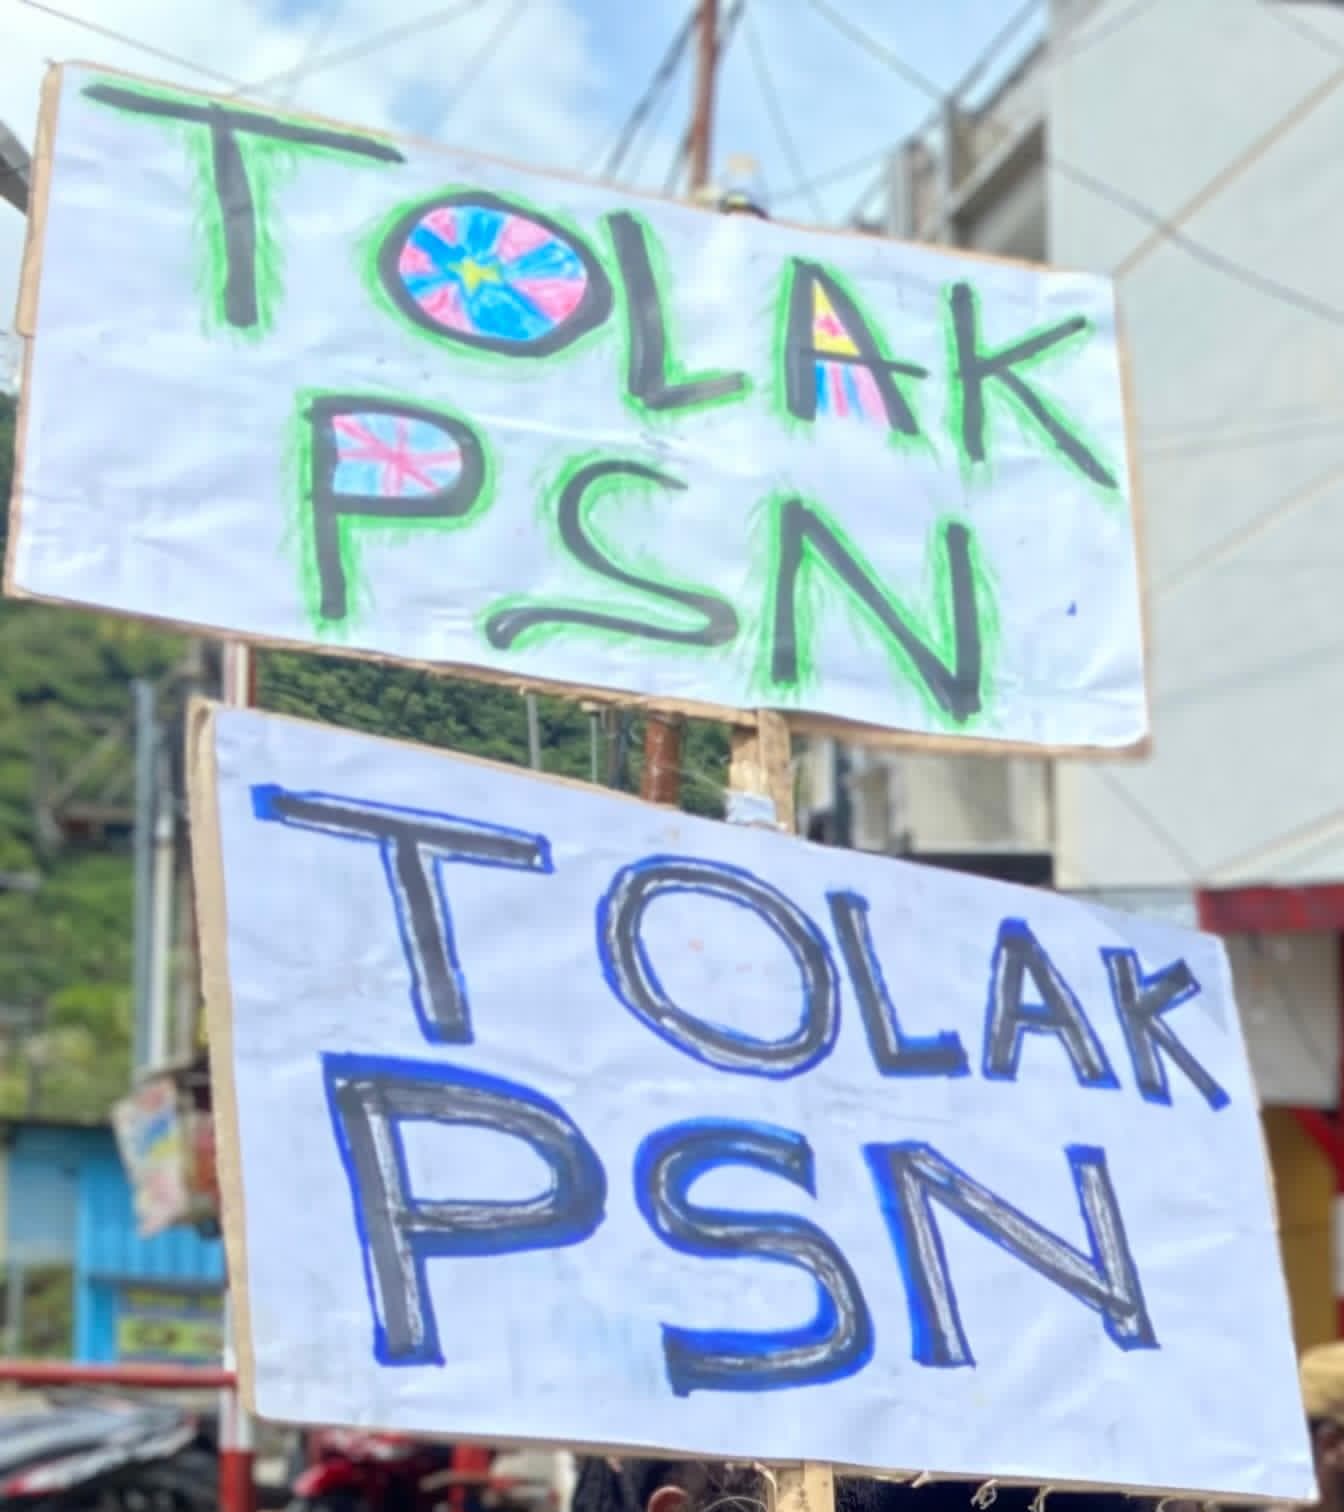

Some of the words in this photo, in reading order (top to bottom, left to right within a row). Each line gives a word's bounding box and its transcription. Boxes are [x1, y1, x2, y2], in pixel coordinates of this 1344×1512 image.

[82, 82, 1118, 490] TOLAK
[306, 394, 984, 724] PSN
[250, 783, 1232, 1112] TOLAK
[320, 1050, 1162, 1398] PSN
